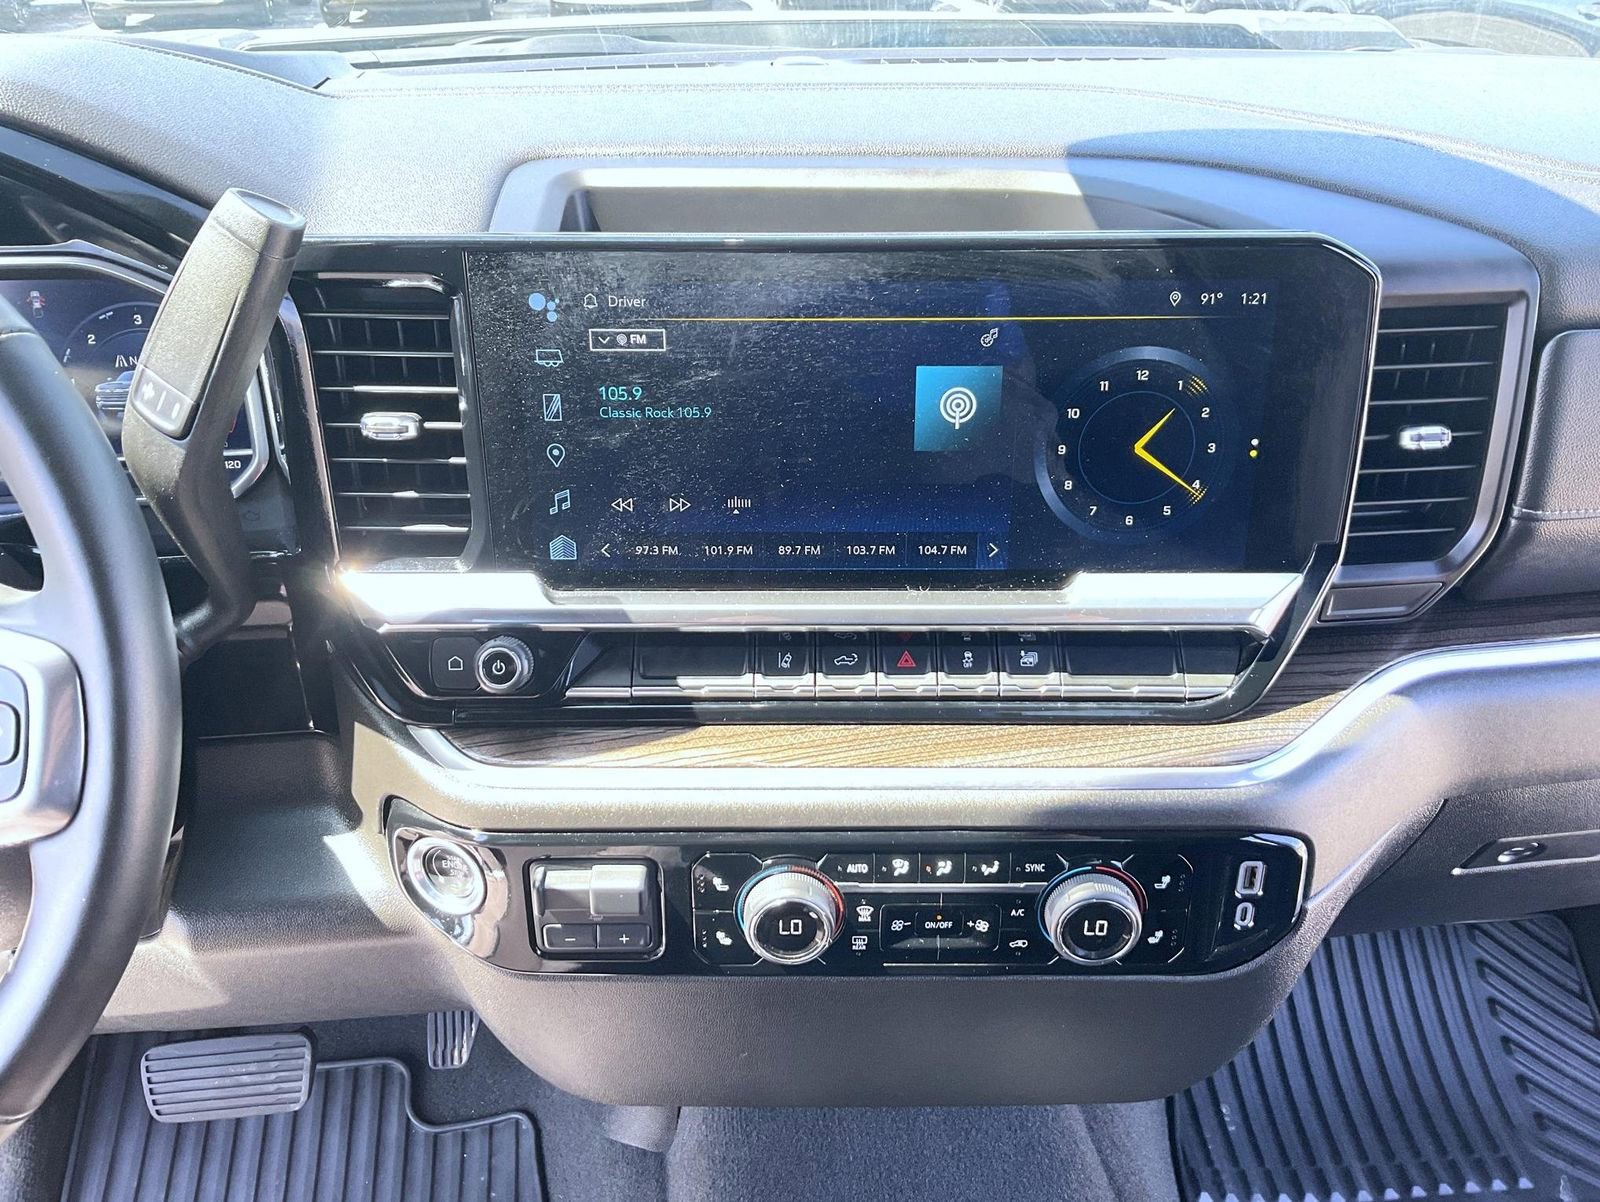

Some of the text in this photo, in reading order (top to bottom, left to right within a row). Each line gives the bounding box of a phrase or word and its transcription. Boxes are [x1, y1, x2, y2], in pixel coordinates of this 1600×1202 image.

[607, 295, 647, 308] Driver
[1241, 293, 1268, 305] 1:21
[133, 314, 143, 325] 3
[87, 334, 97, 345] 2
[630, 334, 647, 345] FM
[1136, 370, 1150, 381] 12
[1099, 381, 1109, 391] 11
[1177, 380, 1184, 391] 1
[599, 387, 643, 401] 105.9
[600, 407, 712, 418] Classic Rock 105.9
[1067, 408, 1080, 419] 10
[1201, 407, 1210, 418] 2
[1057, 445, 1067, 456] 9
[1207, 443, 1217, 453] 3
[1064, 480, 1073, 490] 8
[1191, 479, 1201, 489] 4
[1090, 506, 1098, 516] 7
[1162, 506, 1172, 516] 5
[1125, 516, 1134, 526] 6
[635, 545, 679, 556] 97.3 FM
[704, 545, 753, 556] 101.9 FM
[778, 545, 821, 556] 89.7 FM
[847, 545, 896, 556] 103.7 FM
[918, 545, 967, 556] 104.7 FM
[847, 863, 869, 874] AUTO
[1024, 863, 1045, 873] SYNC
[1011, 908, 1025, 918] A/C
[779, 919, 802, 936] LO
[925, 921, 953, 930] ON/OFF
[1083, 920, 1108, 936] LO
